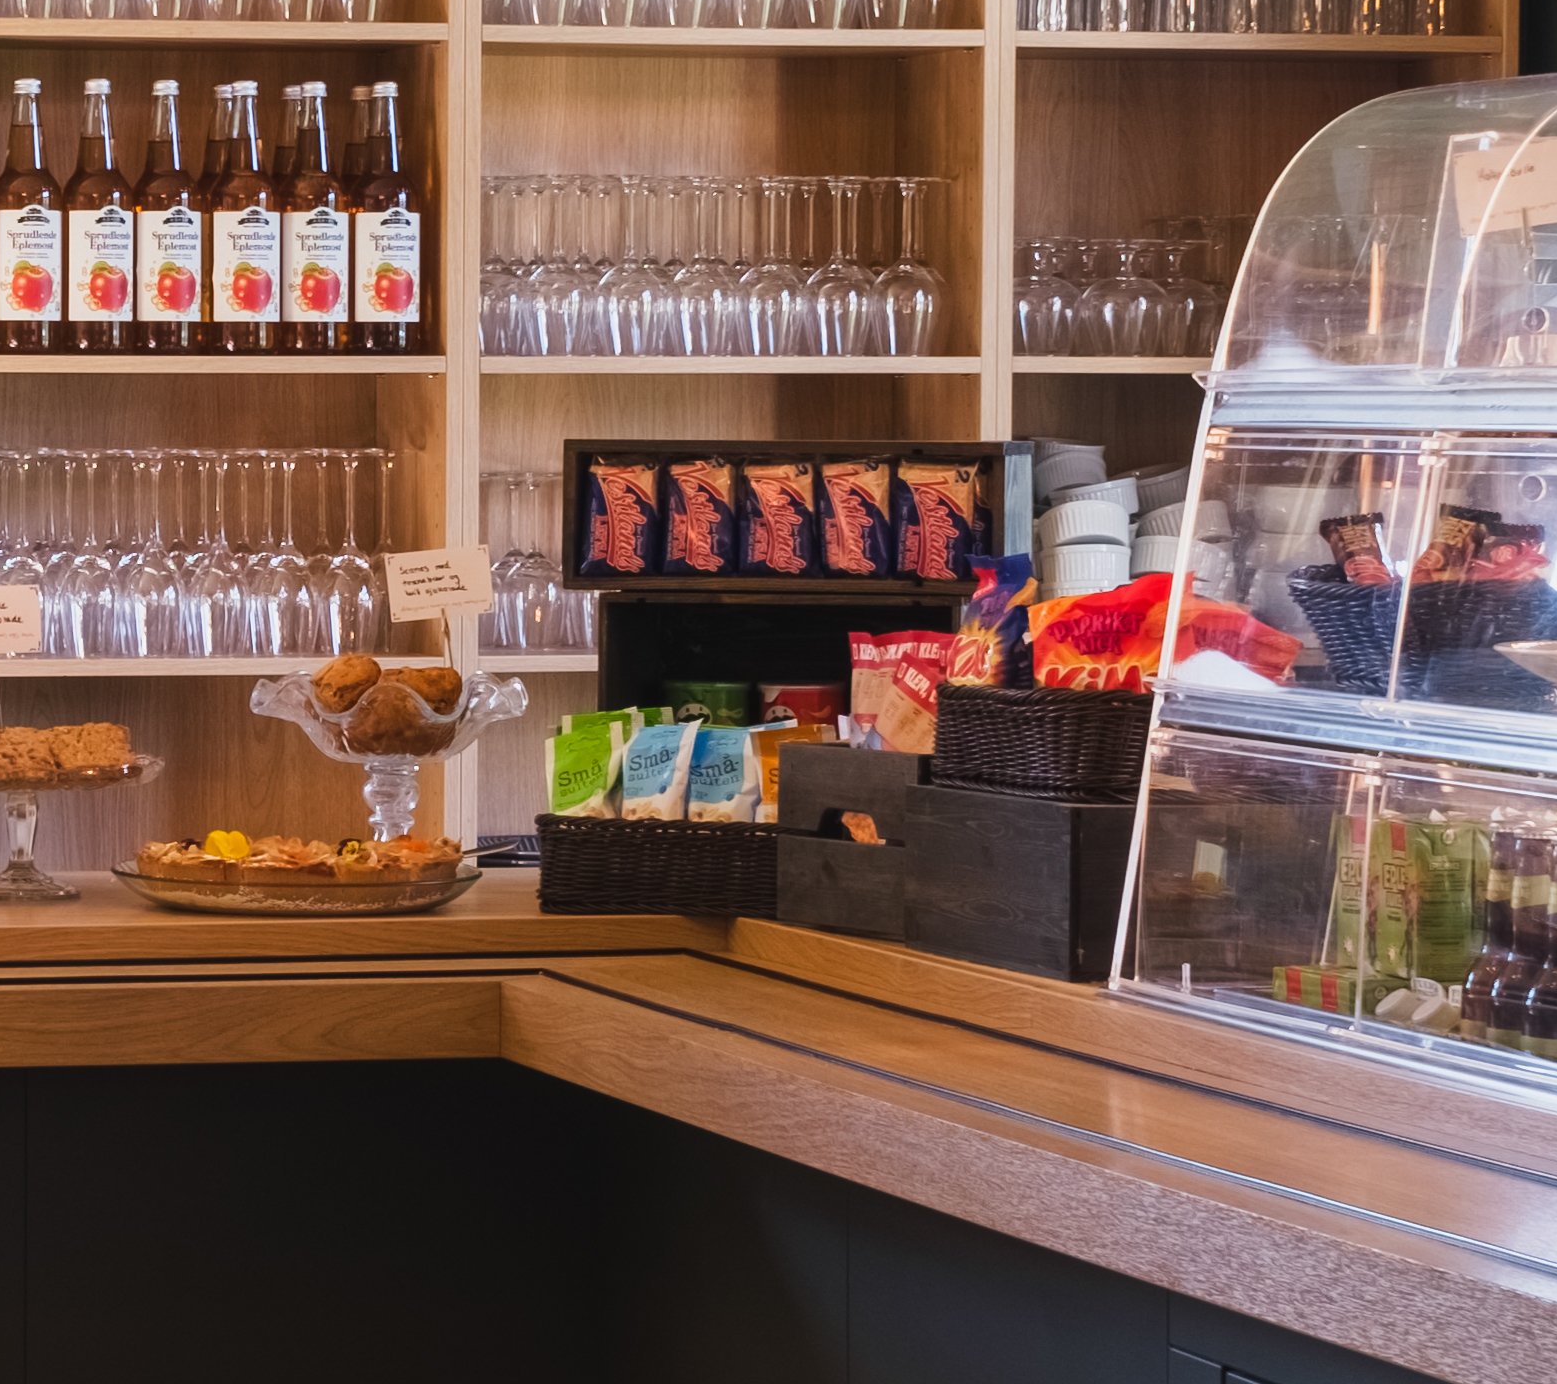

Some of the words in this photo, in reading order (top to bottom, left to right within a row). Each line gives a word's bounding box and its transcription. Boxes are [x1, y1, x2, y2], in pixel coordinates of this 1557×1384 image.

[6, 229, 57, 240] Sprudlende
[83, 230, 131, 242] Sprudlende
[151, 231, 199, 242] Sprudlende
[226, 231, 276, 242] Sprudlende
[295, 231, 345, 242] Sprudlende
[369, 232, 417, 242] Sprudlende
[12, 239, 54, 251] Eplemost
[89, 240, 129, 252] Eplemost
[157, 240, 197, 252] Eplemost
[232, 240, 274, 252] Eplemost
[301, 241, 342, 252] Eplemost
[374, 241, 415, 253] Eplemost
[596, 466, 654, 574] Vestlands
[670, 461, 726, 572] Vestlands
[749, 468, 807, 575] Vestlands
[824, 466, 877, 576] Vestlands
[1073, 633, 1124, 656] KICK
